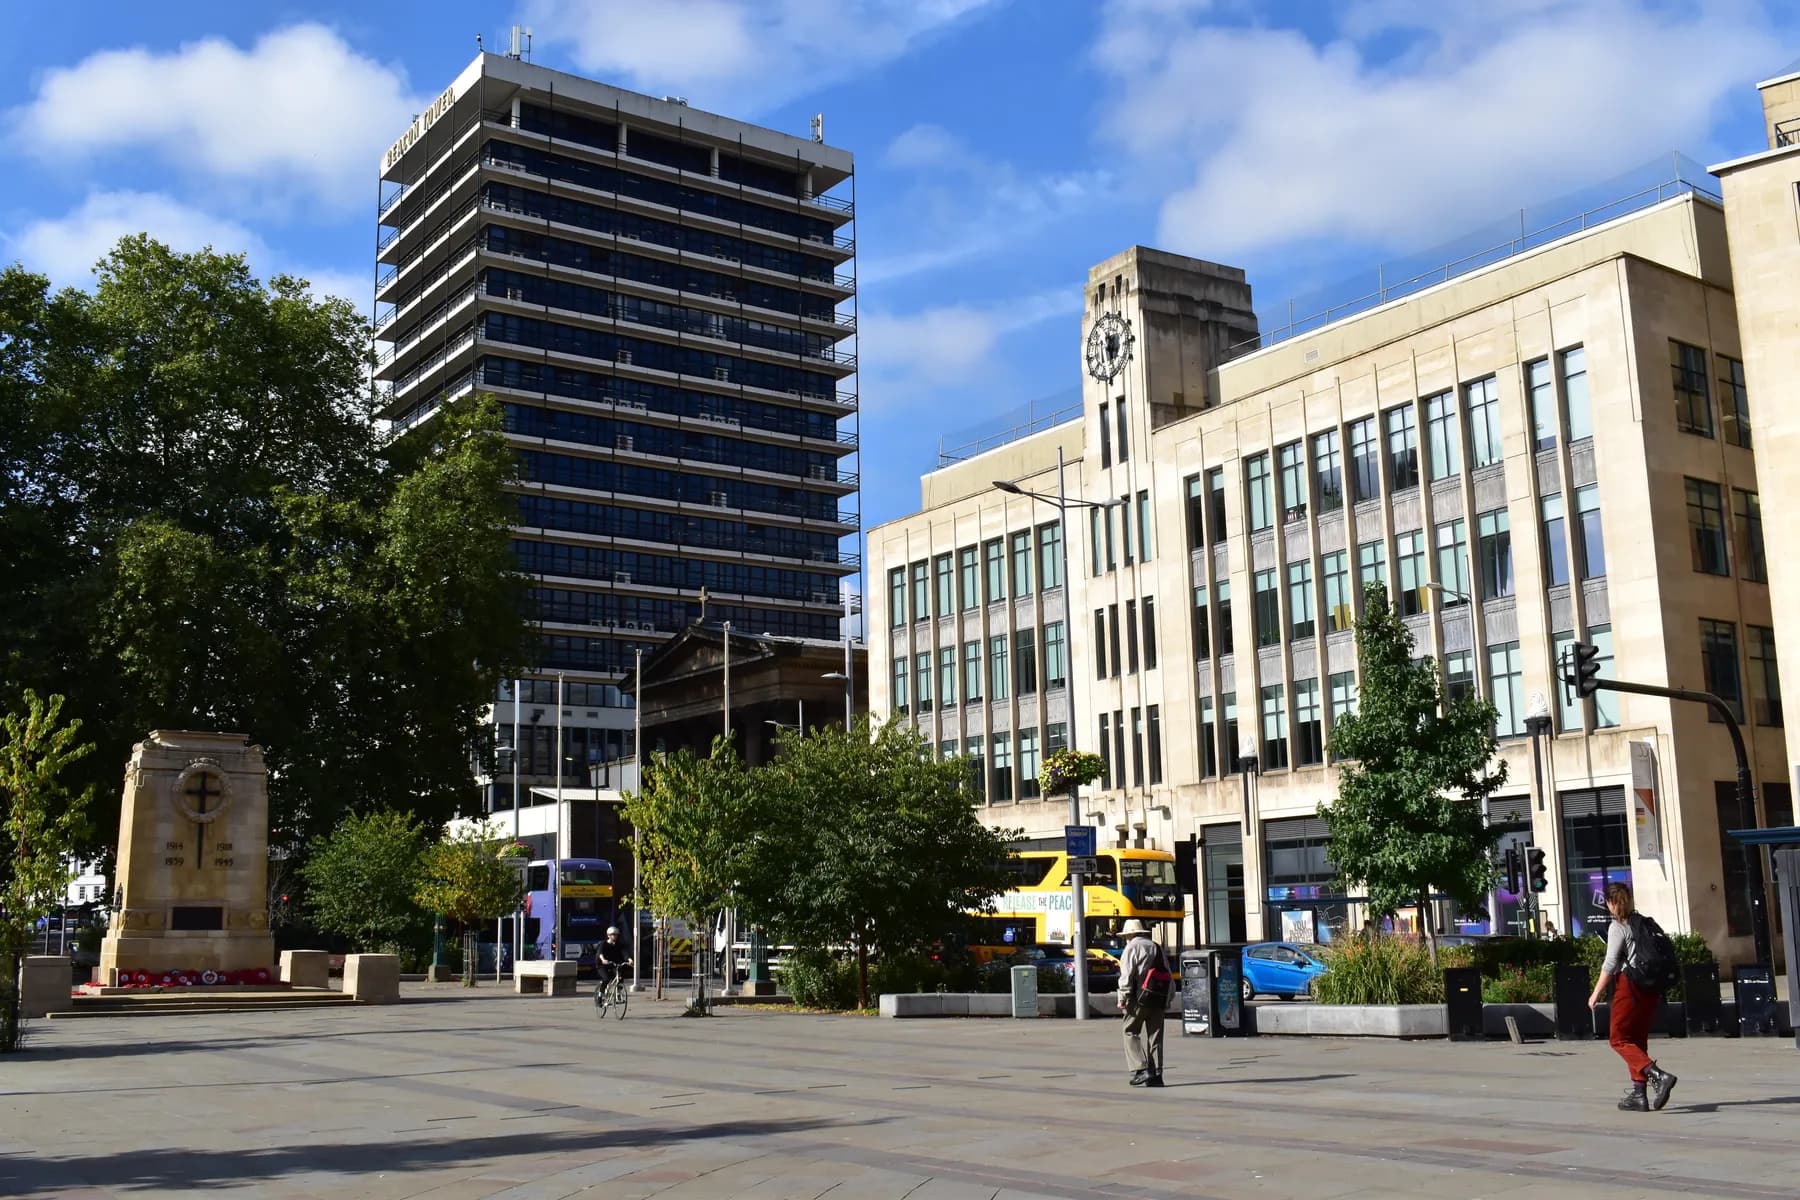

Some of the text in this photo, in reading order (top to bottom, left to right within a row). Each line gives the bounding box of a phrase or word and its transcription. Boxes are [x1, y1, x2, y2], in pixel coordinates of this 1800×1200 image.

[387, 87, 454, 168] BEACON TOWER
[167, 841, 184, 850] 1914
[165, 857, 234, 867] 1939 1945
[1003, 895, 1037, 910] RELEASE
[1048, 895, 1073, 911] PEAC
